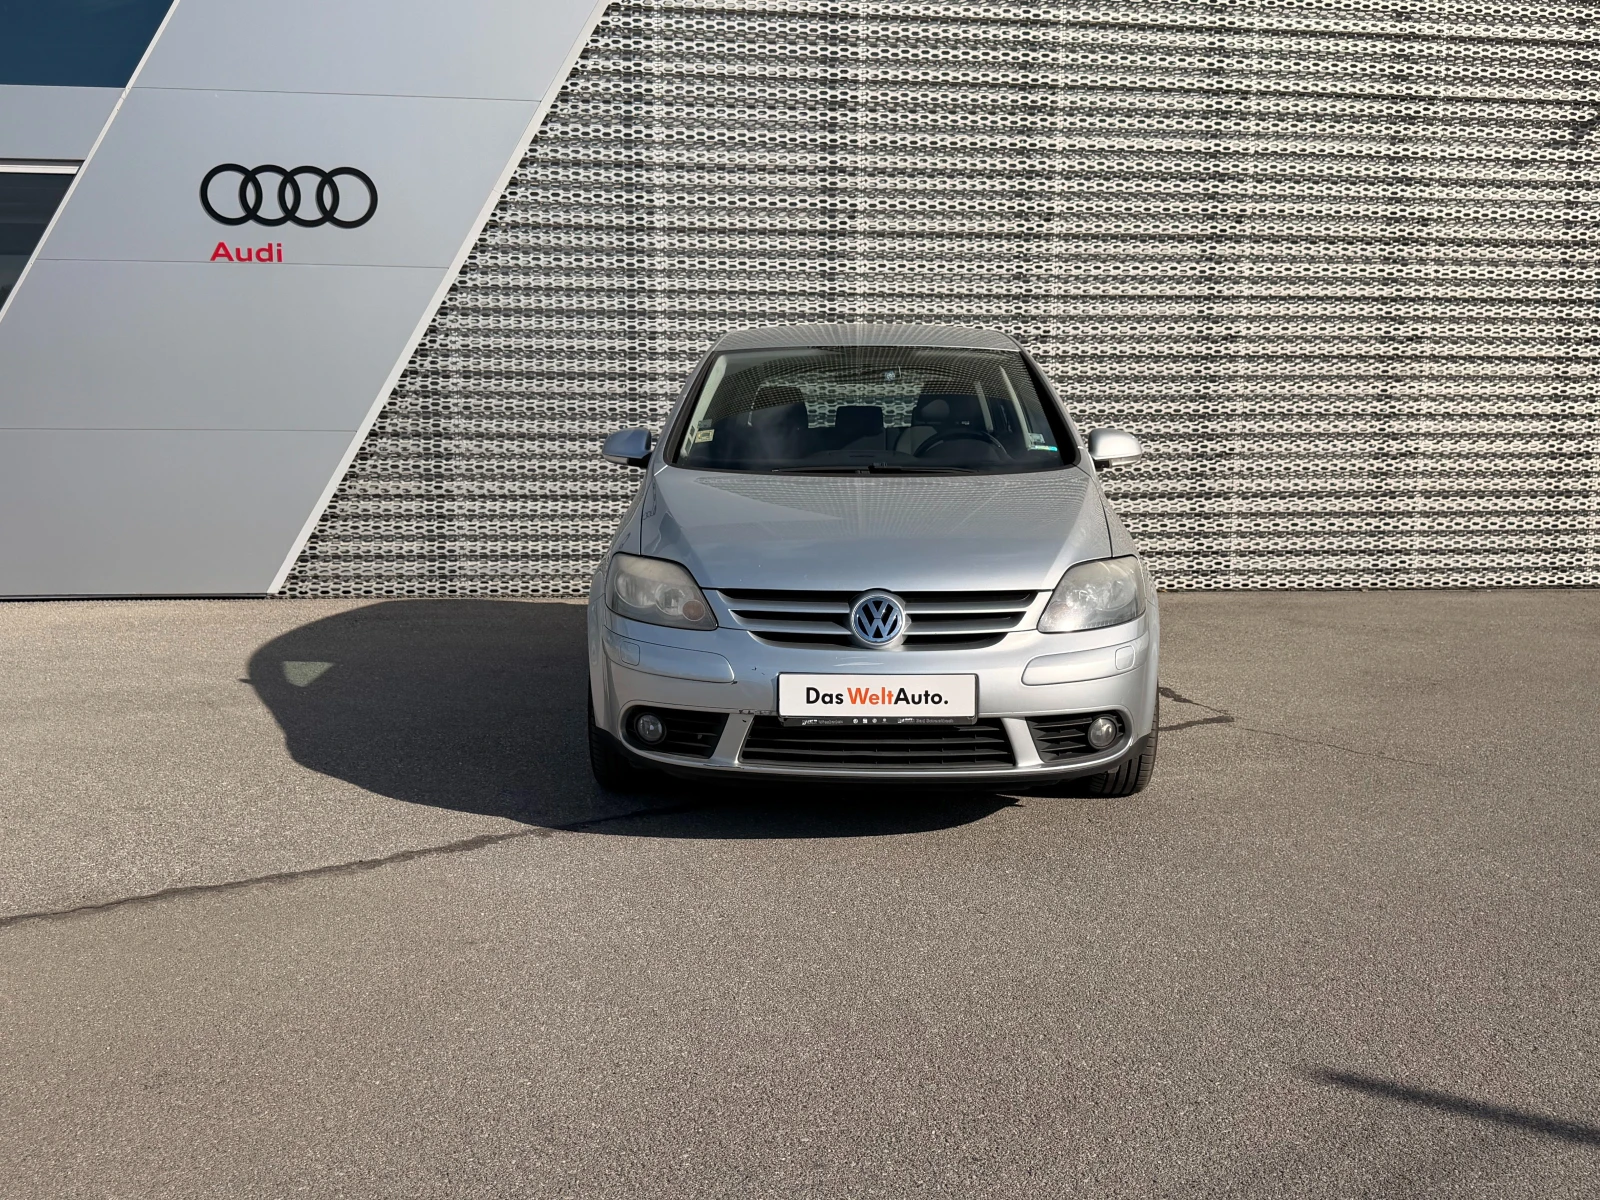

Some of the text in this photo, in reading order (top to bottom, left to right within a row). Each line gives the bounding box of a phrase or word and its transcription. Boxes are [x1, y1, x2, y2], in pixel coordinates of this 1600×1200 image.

[210, 241, 283, 263] Audi
[854, 597, 902, 642] VW
[806, 686, 949, 705] Das WeltAuto.
